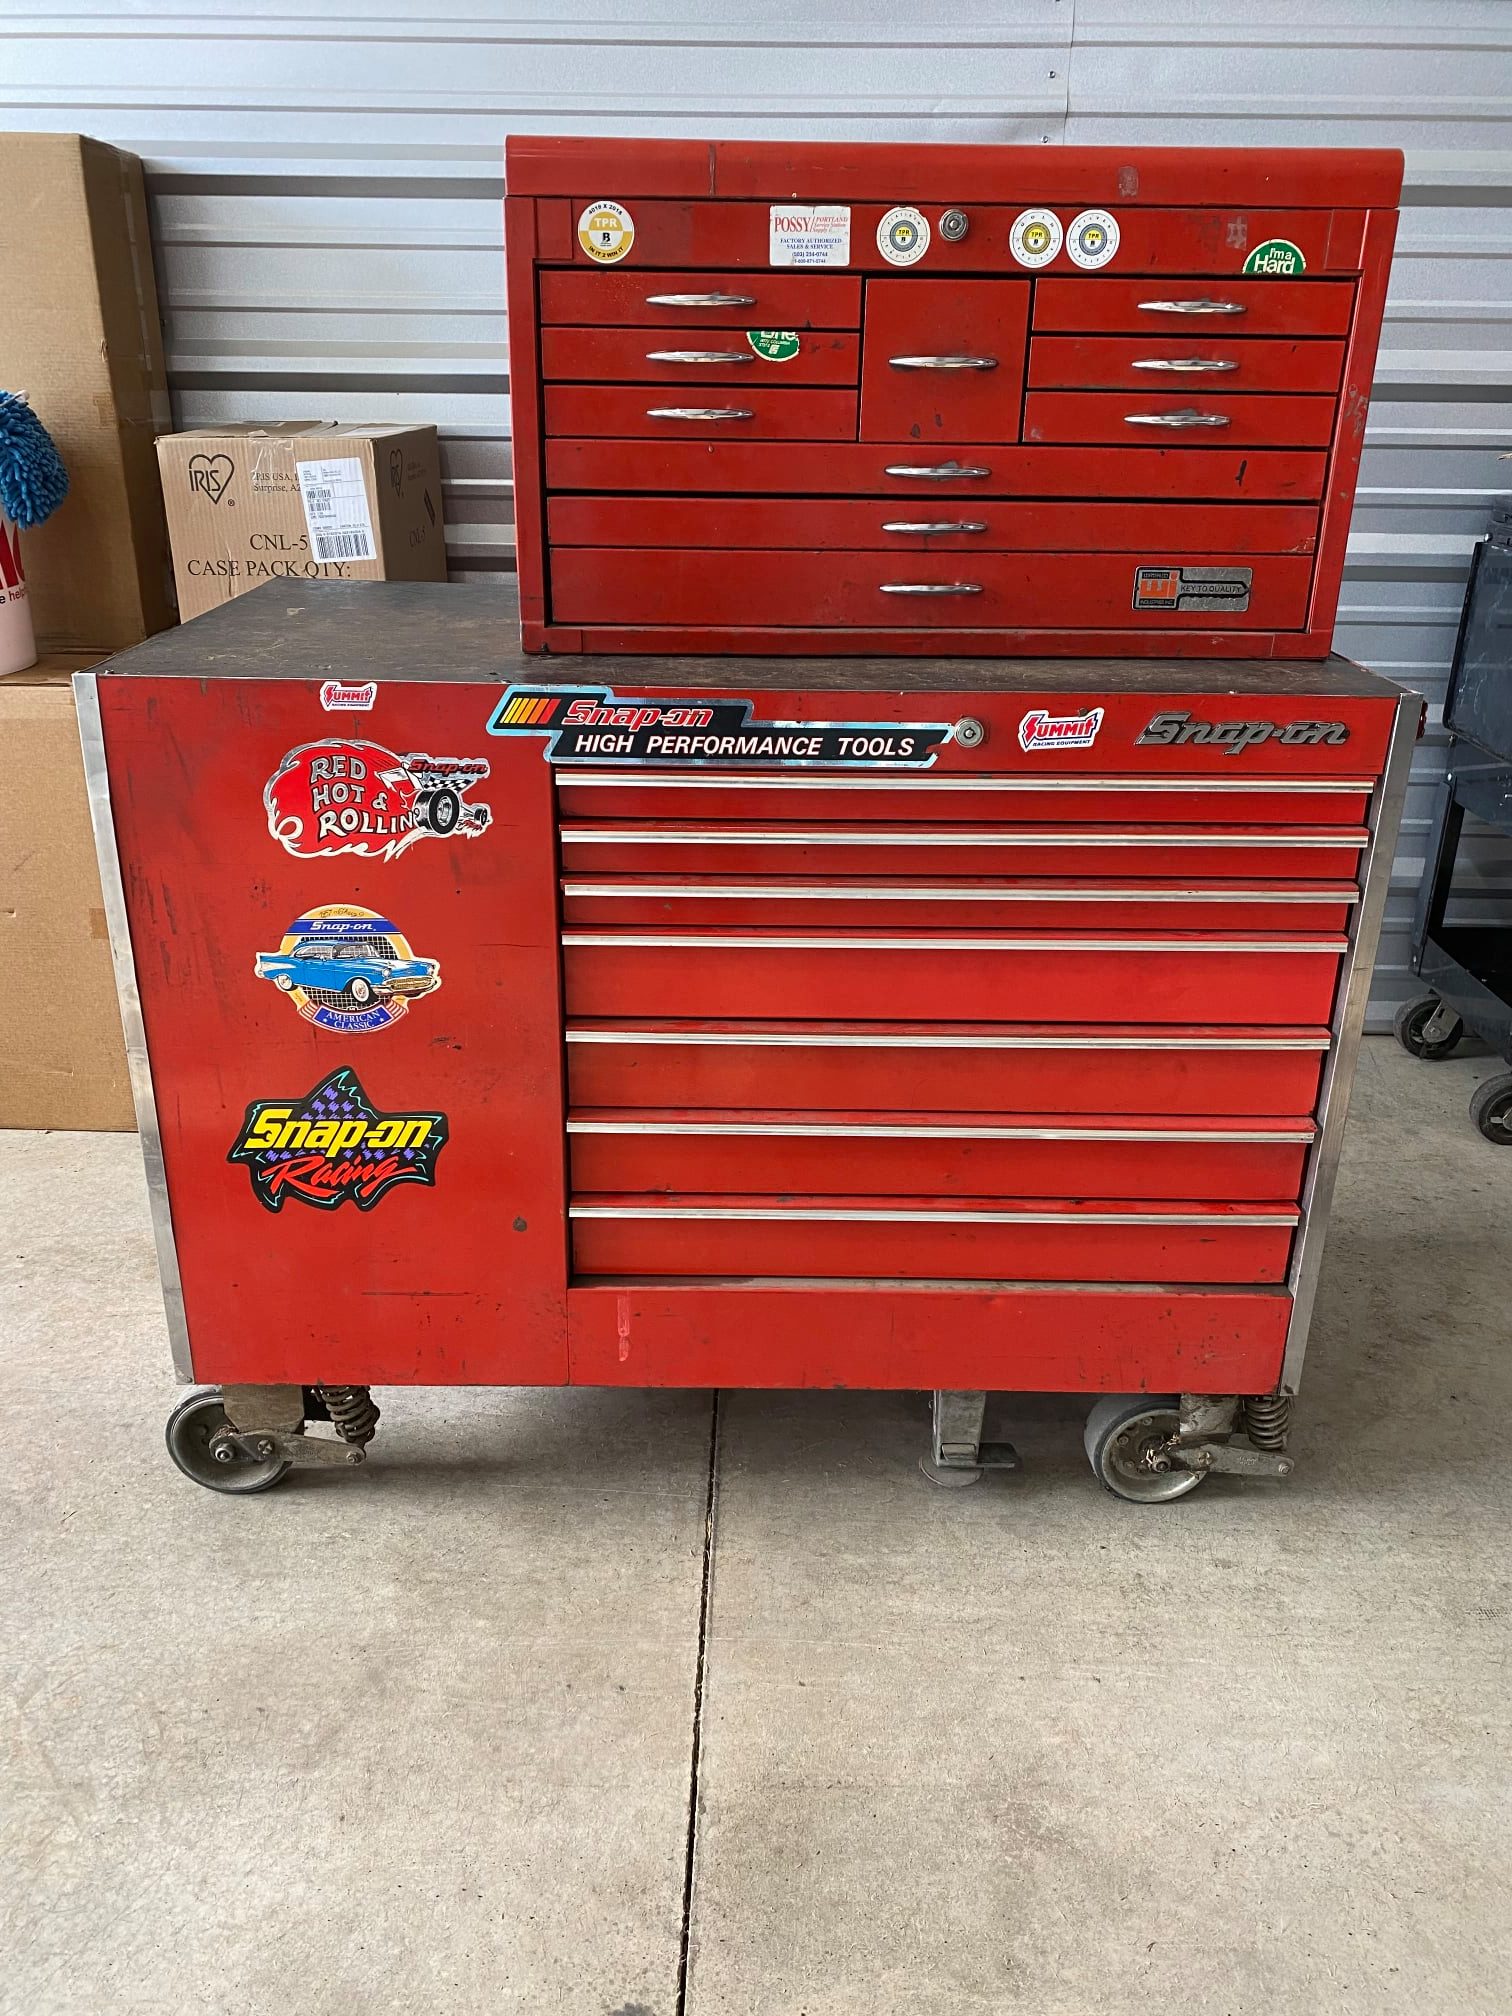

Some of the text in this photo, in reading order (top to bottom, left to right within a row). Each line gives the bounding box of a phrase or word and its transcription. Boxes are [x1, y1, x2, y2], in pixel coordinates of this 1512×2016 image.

[594, 218, 617, 228] TPR
[775, 216, 810, 232] POSSY
[1254, 253, 1296, 274] Hard
[1270, 247, 1292, 260] I'm a
[189, 469, 221, 491] IRIS
[254, 484, 288, 493] Surprise,
[187, 559, 350, 578] CASE PACK QTY:
[562, 699, 714, 732] Snap-on
[1134, 711, 1349, 755] Snap-on
[575, 734, 915, 756] HIGH PERFORMANCE TOOLS
[310, 755, 367, 784] RED
[408, 759, 488, 777] Snap-on
[312, 782, 388, 812] HOT &
[310, 921, 373, 932] Snap-on
[326, 1010, 380, 1023] AMERICAN
[334, 1020, 374, 1030] CLASSIC
[244, 1108, 433, 1157] Snap-on
[262, 1155, 417, 1197] Racing
